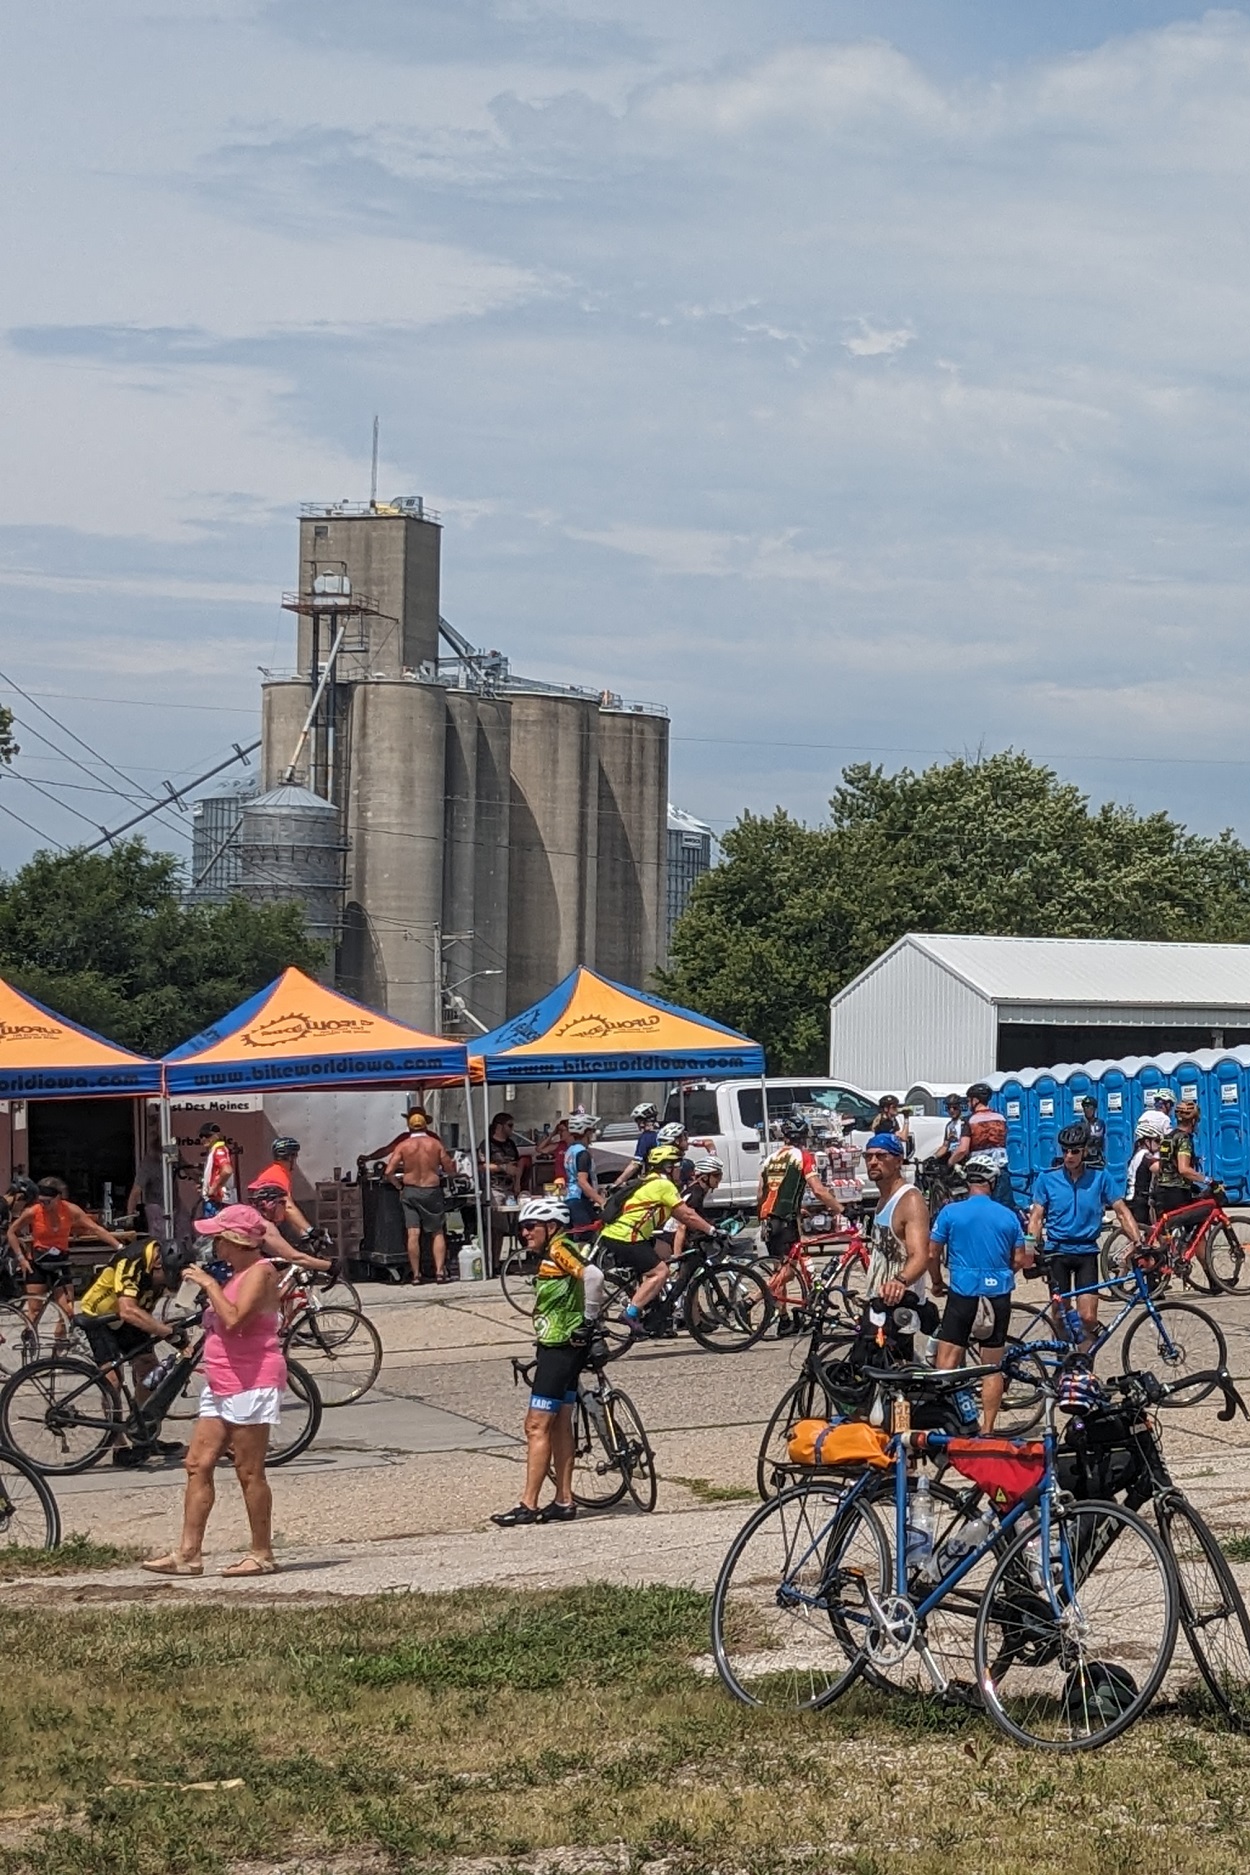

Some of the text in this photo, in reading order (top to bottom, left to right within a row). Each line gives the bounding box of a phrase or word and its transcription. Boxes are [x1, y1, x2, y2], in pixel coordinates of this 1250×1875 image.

[194, 1057, 443, 1086] www.bikeworldiowa.com
[186, 1102, 206, 1111] Des
[209, 1100, 250, 1111] Moines
